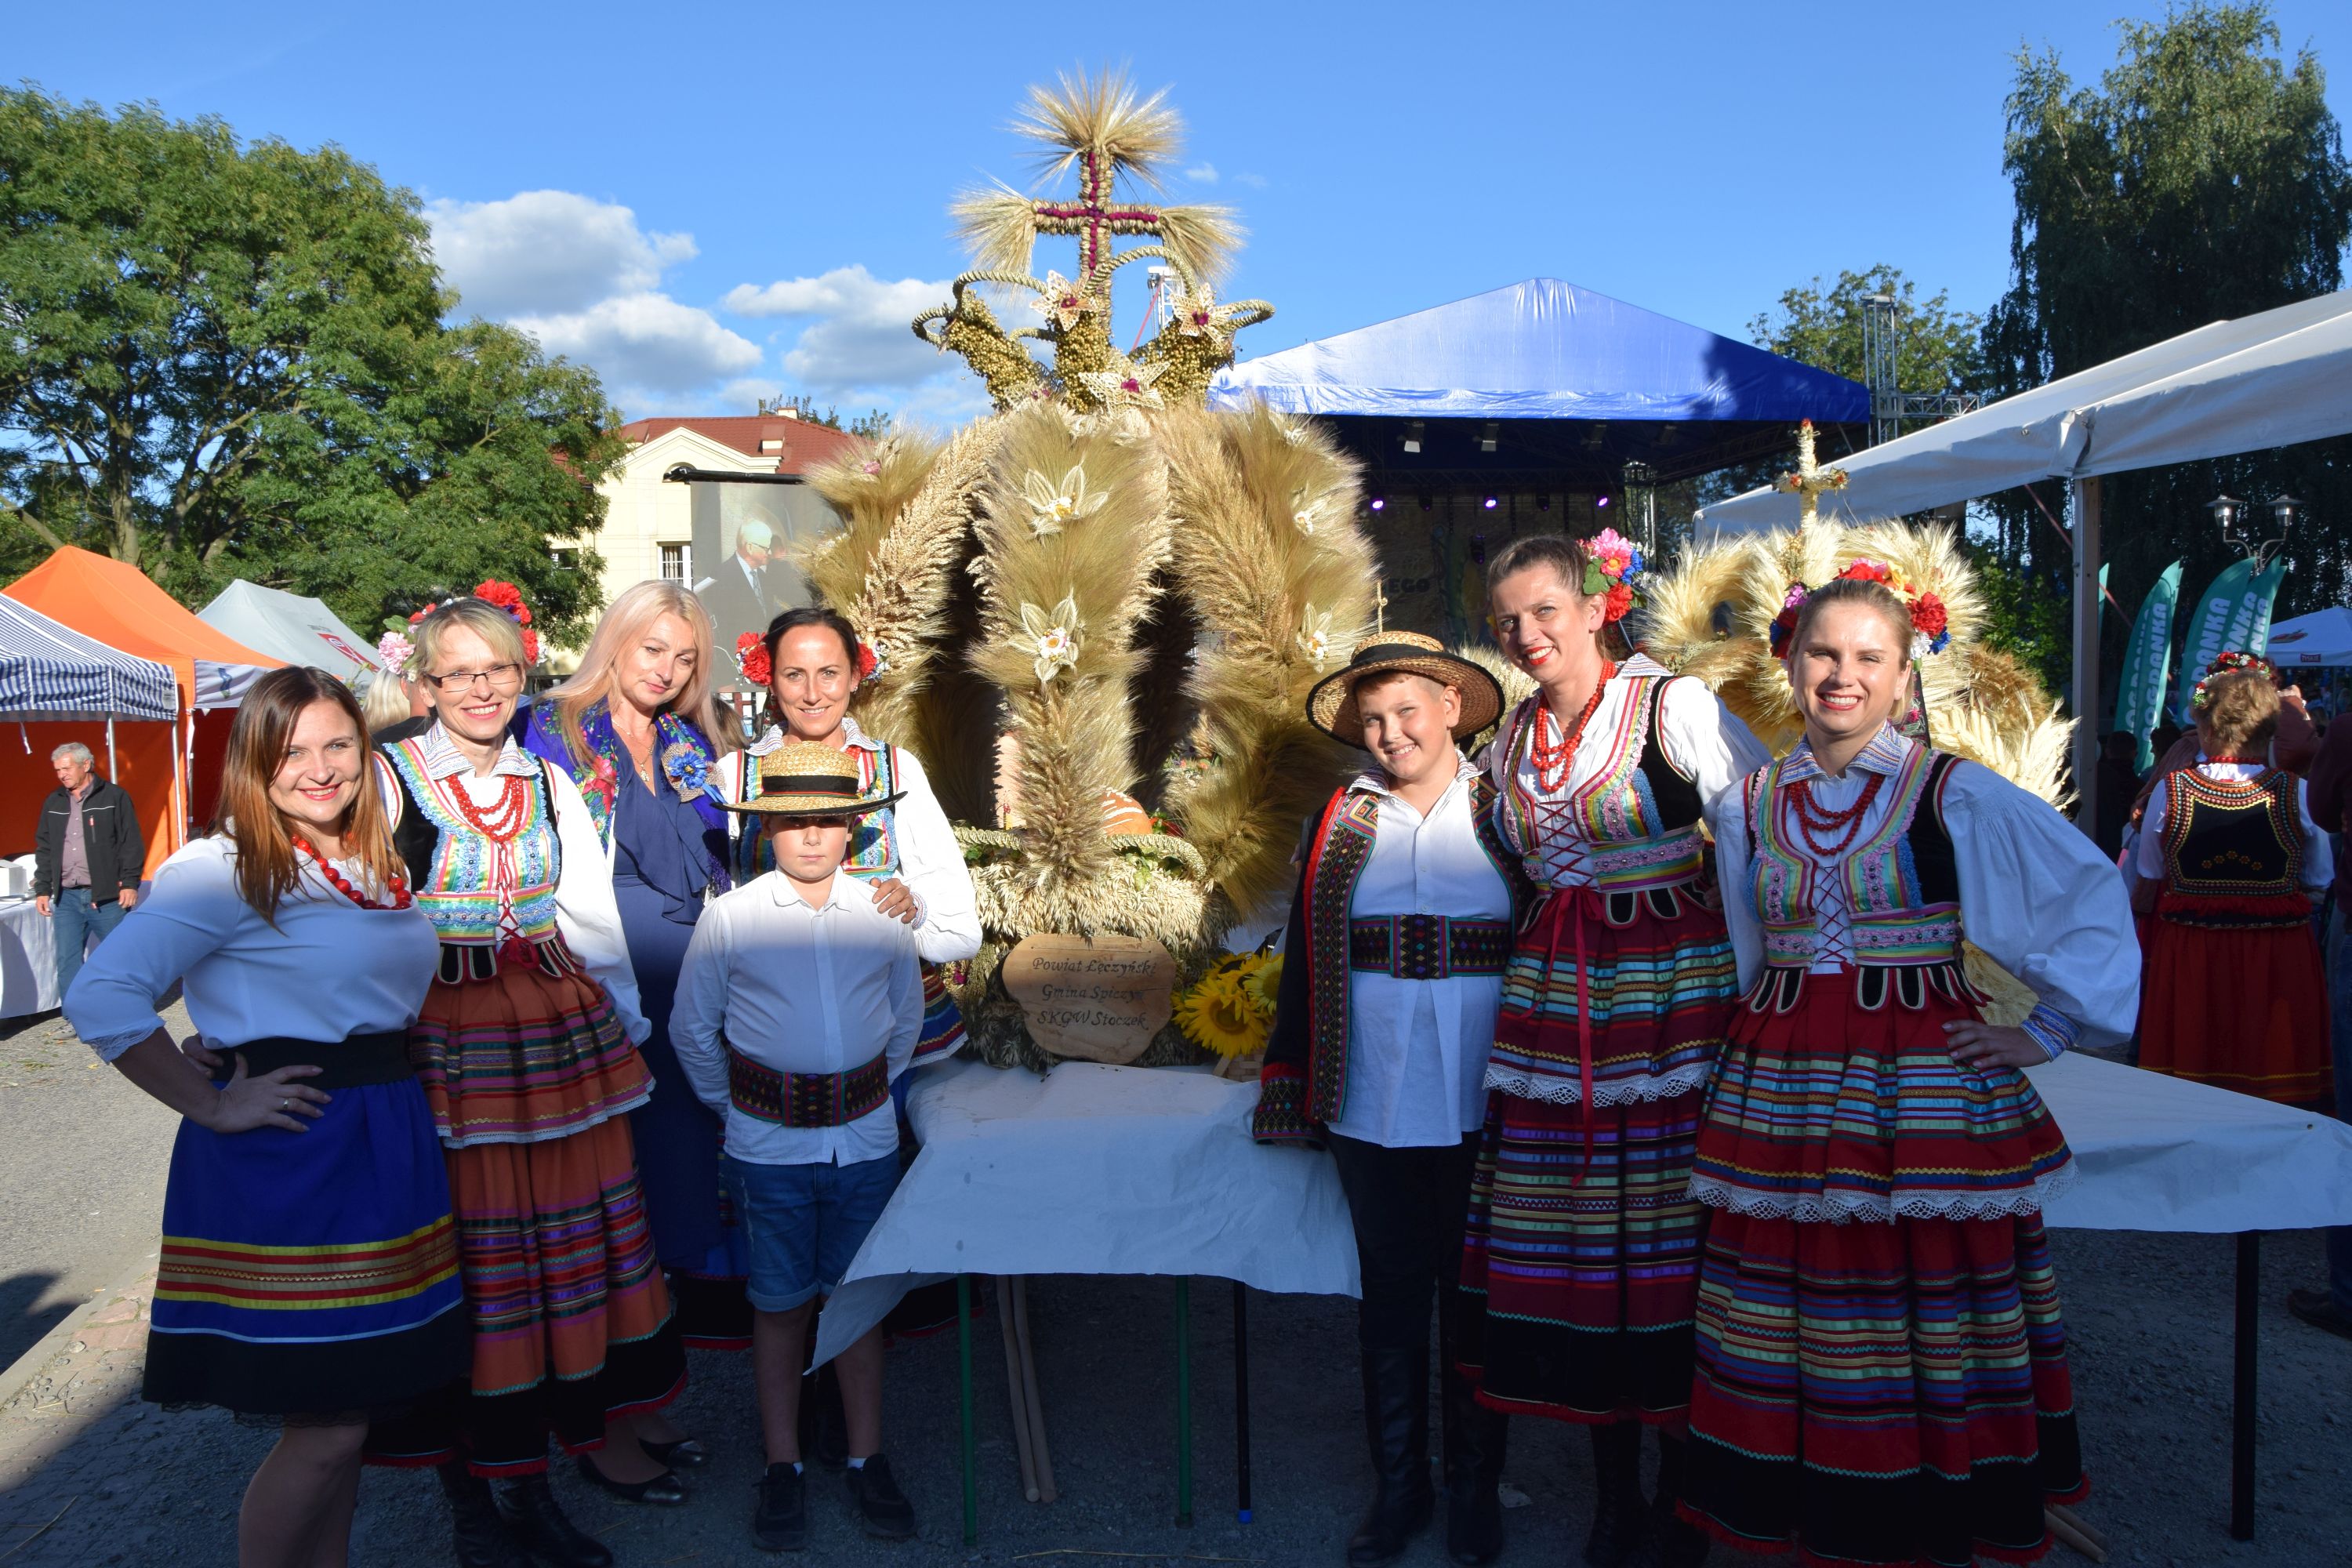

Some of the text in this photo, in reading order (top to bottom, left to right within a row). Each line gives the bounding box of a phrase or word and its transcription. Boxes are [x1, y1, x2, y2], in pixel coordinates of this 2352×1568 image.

[1033, 957, 1156, 978] Powiat Łęczyński
[1042, 985, 1087, 1000] Gmina
[1036, 1011, 1149, 1030] SKGW Stoczek
